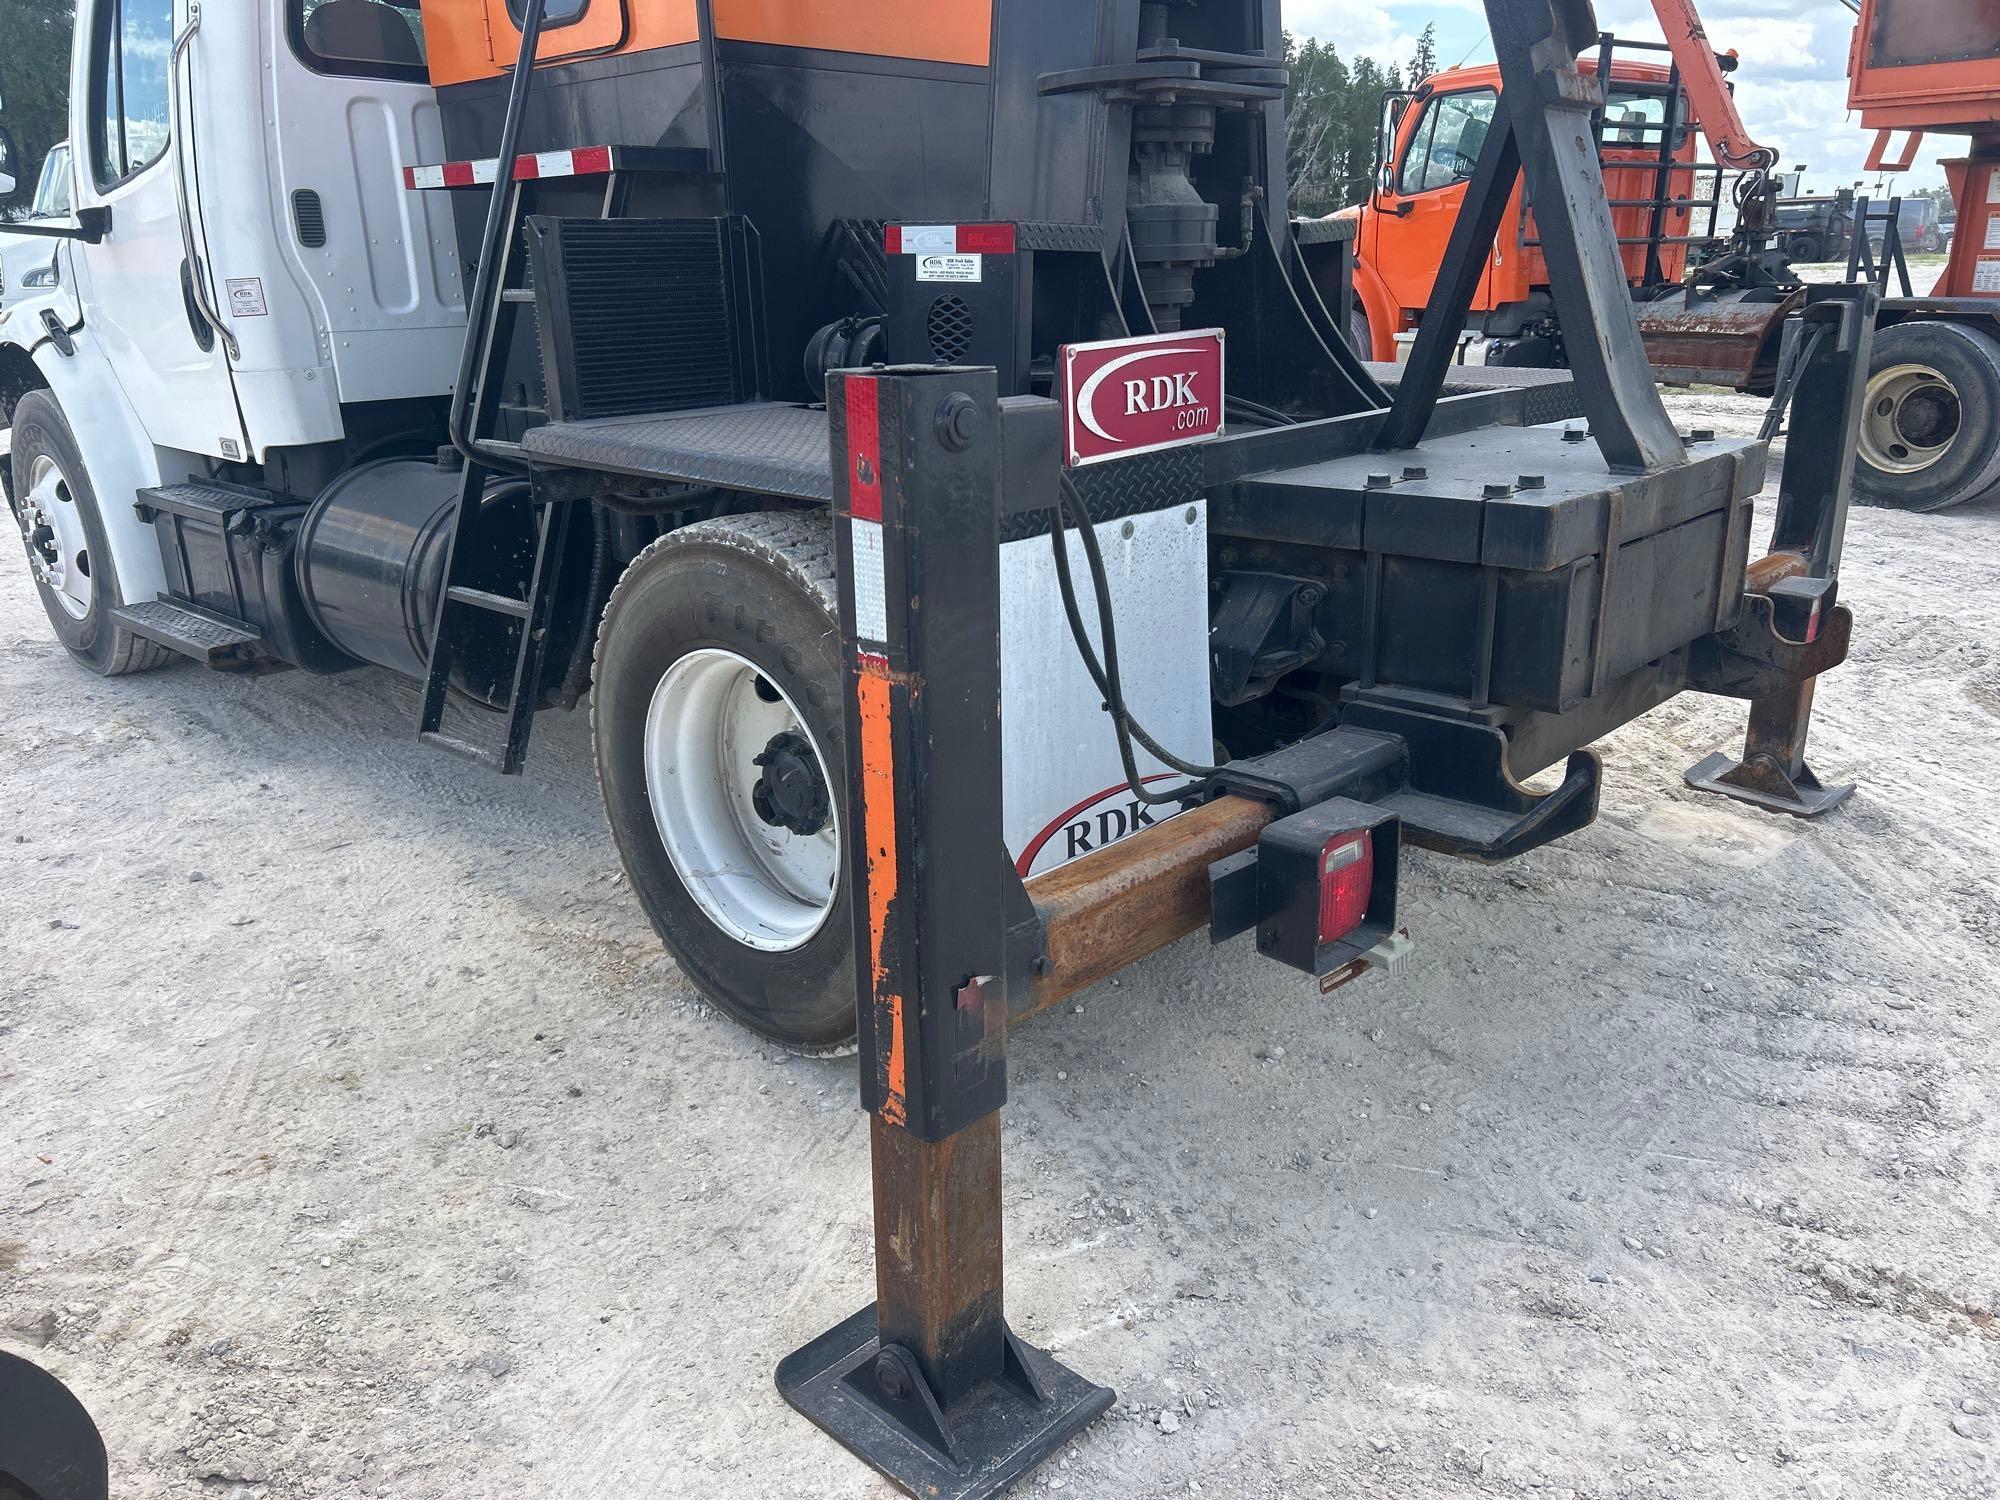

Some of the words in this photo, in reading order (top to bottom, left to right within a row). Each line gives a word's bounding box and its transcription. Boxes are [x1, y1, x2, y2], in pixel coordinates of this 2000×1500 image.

[1122, 370, 1199, 416] RDK
[1170, 405, 1209, 432] .com
[1064, 800, 1156, 860] RDK
